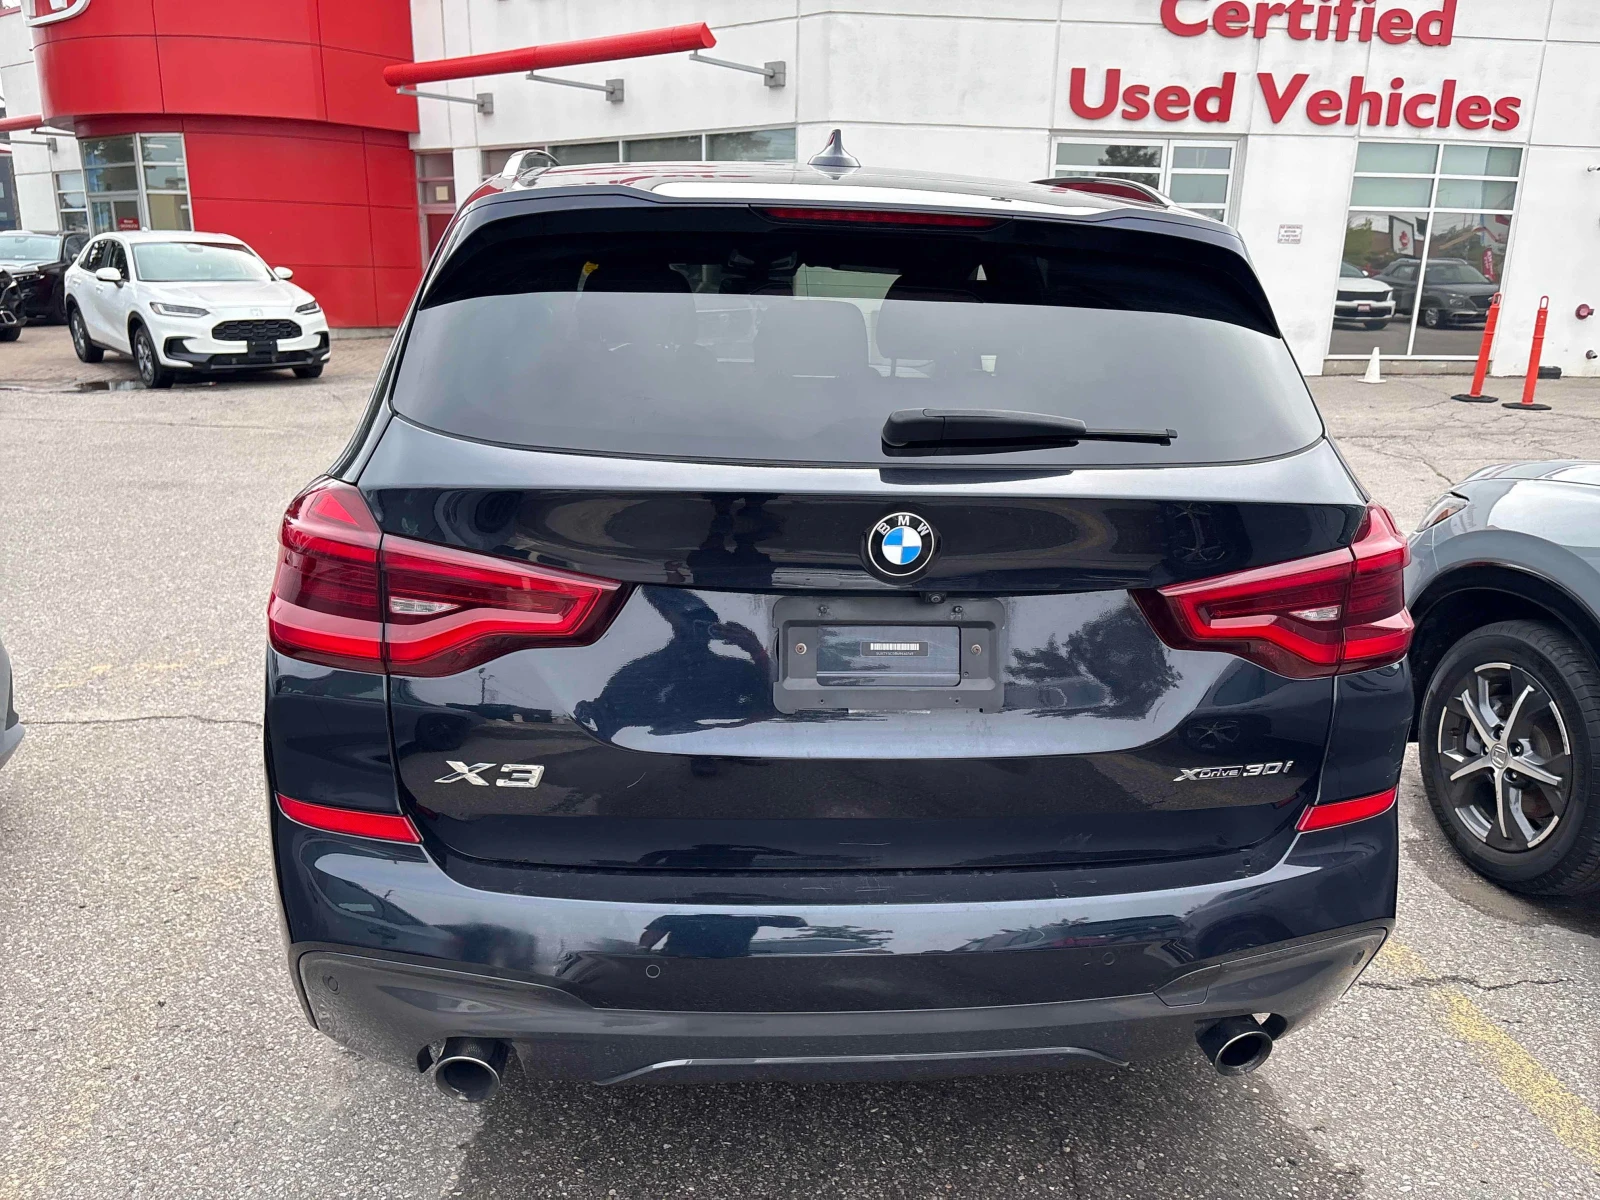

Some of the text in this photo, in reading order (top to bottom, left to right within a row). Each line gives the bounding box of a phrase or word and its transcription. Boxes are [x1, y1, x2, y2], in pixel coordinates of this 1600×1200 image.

[1161, 0, 1457, 47] Certified
[1069, 68, 1522, 132] Used Vehicles
[876, 515, 931, 536] BMW
[434, 760, 544, 789] X3
